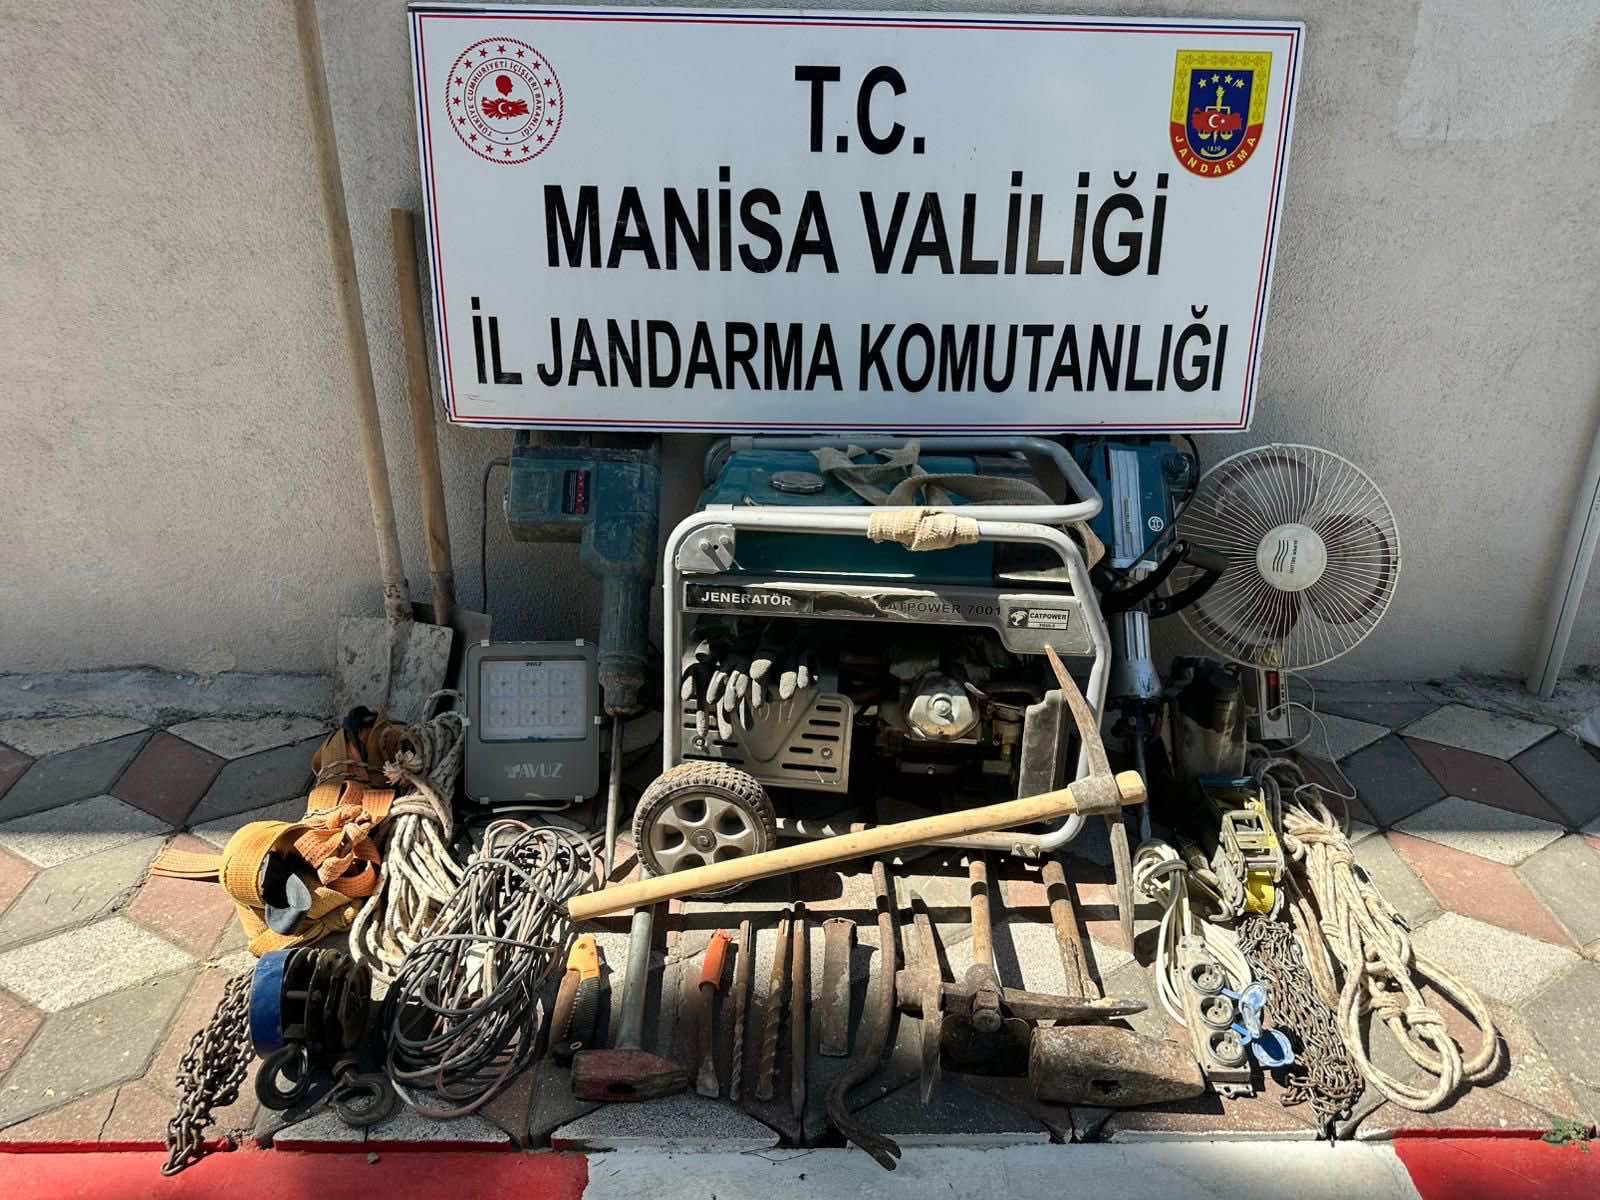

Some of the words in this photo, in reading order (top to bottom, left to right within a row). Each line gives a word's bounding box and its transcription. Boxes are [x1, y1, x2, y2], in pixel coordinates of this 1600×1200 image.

[795, 66, 926, 155] T.C.
[1175, 135, 1257, 175] JANDARMA
[544, 166, 840, 274] MANİSA
[859, 171, 1169, 277] VALİLİĞİ
[470, 297, 523, 385] İL
[537, 317, 844, 392] JANDARMA
[858, 304, 1229, 393] KOMUTANLIĞI
[700, 590, 793, 607] JENERATÖR
[1029, 612, 1067, 620] CATPOWER
